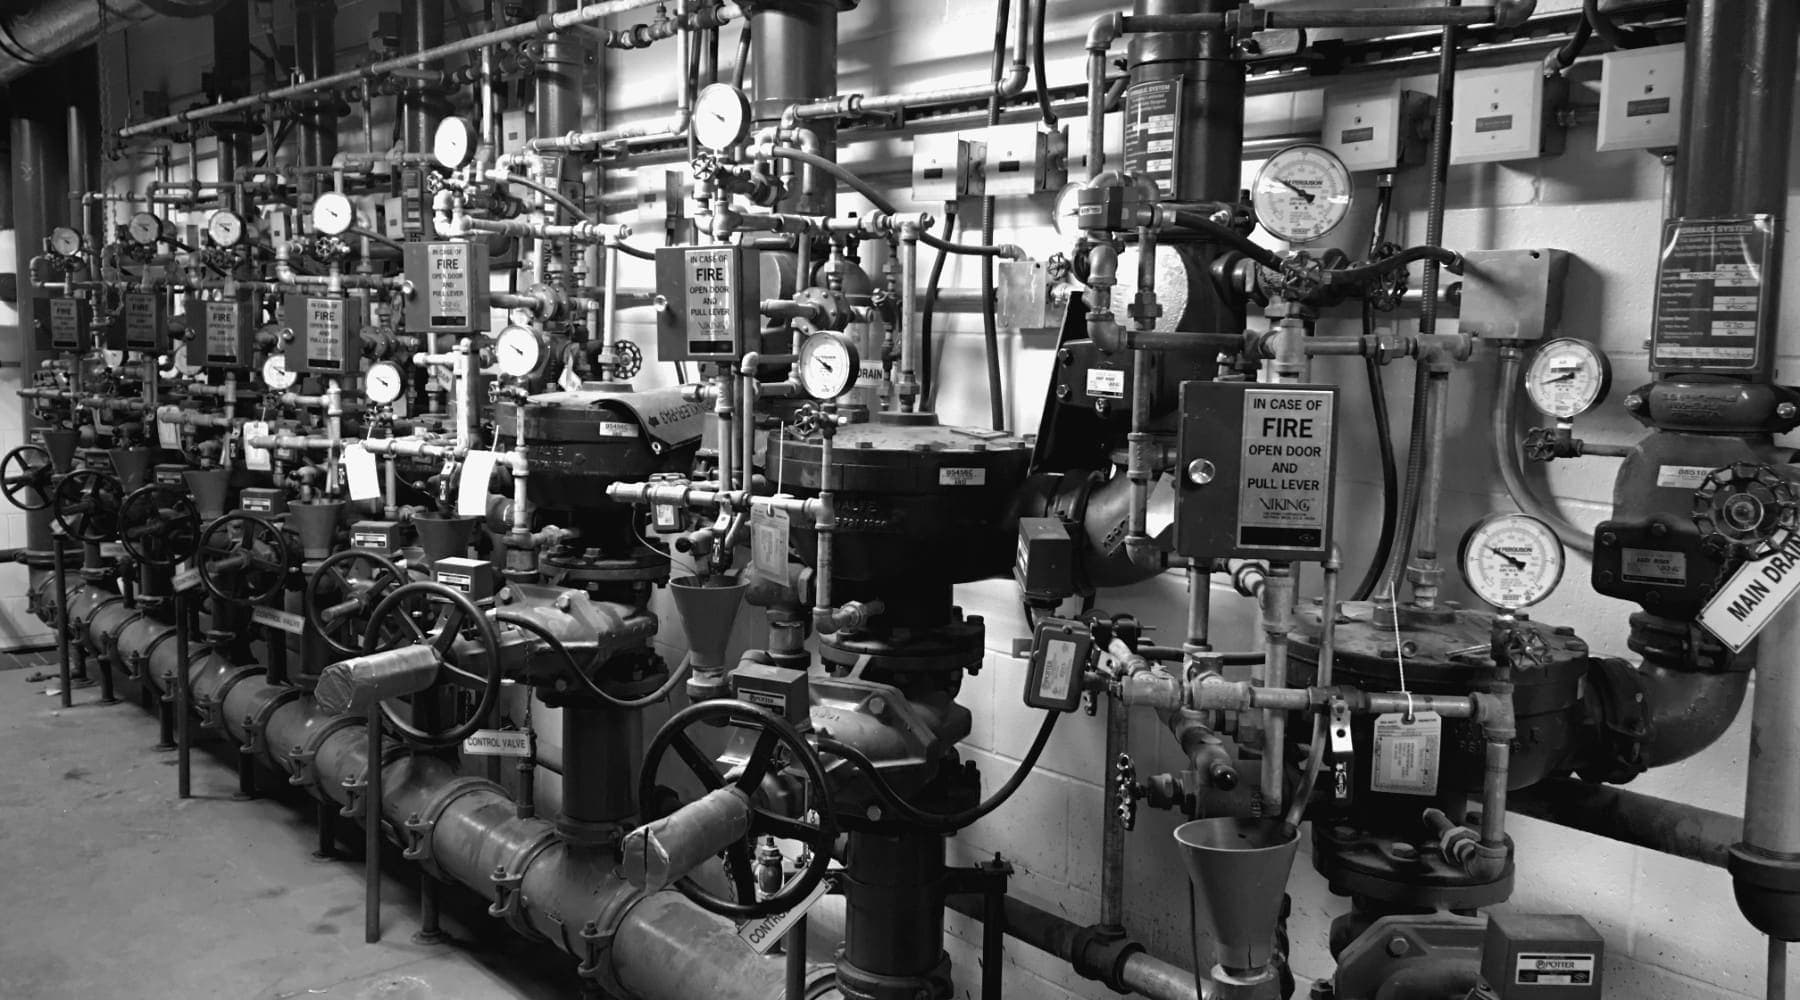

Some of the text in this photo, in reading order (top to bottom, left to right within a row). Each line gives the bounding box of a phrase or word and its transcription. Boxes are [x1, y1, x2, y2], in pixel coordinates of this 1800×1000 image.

[436, 258, 459, 270] FIRE
[690, 255, 727, 264] IN CASE OF
[696, 267, 724, 281] FIRE
[690, 286, 728, 294] OPEN DOOR
[213, 313, 231, 322] FIRE
[315, 311, 336, 321] FIRE
[708, 308, 730, 316] LEVER
[1253, 398, 1323, 410] IN CASE OF
[1262, 417, 1313, 438] FIRE
[1248, 444, 1322, 458] OPEN DOOR
[1271, 462, 1298, 474] AND
[1247, 478, 1320, 490] PULL LEVER
[1259, 497, 1311, 512] VIKING
[1726, 579, 1770, 622] MAIN
[467, 737, 526, 749] CONTROL VALVE
[1545, 961, 1575, 970] POTTER
